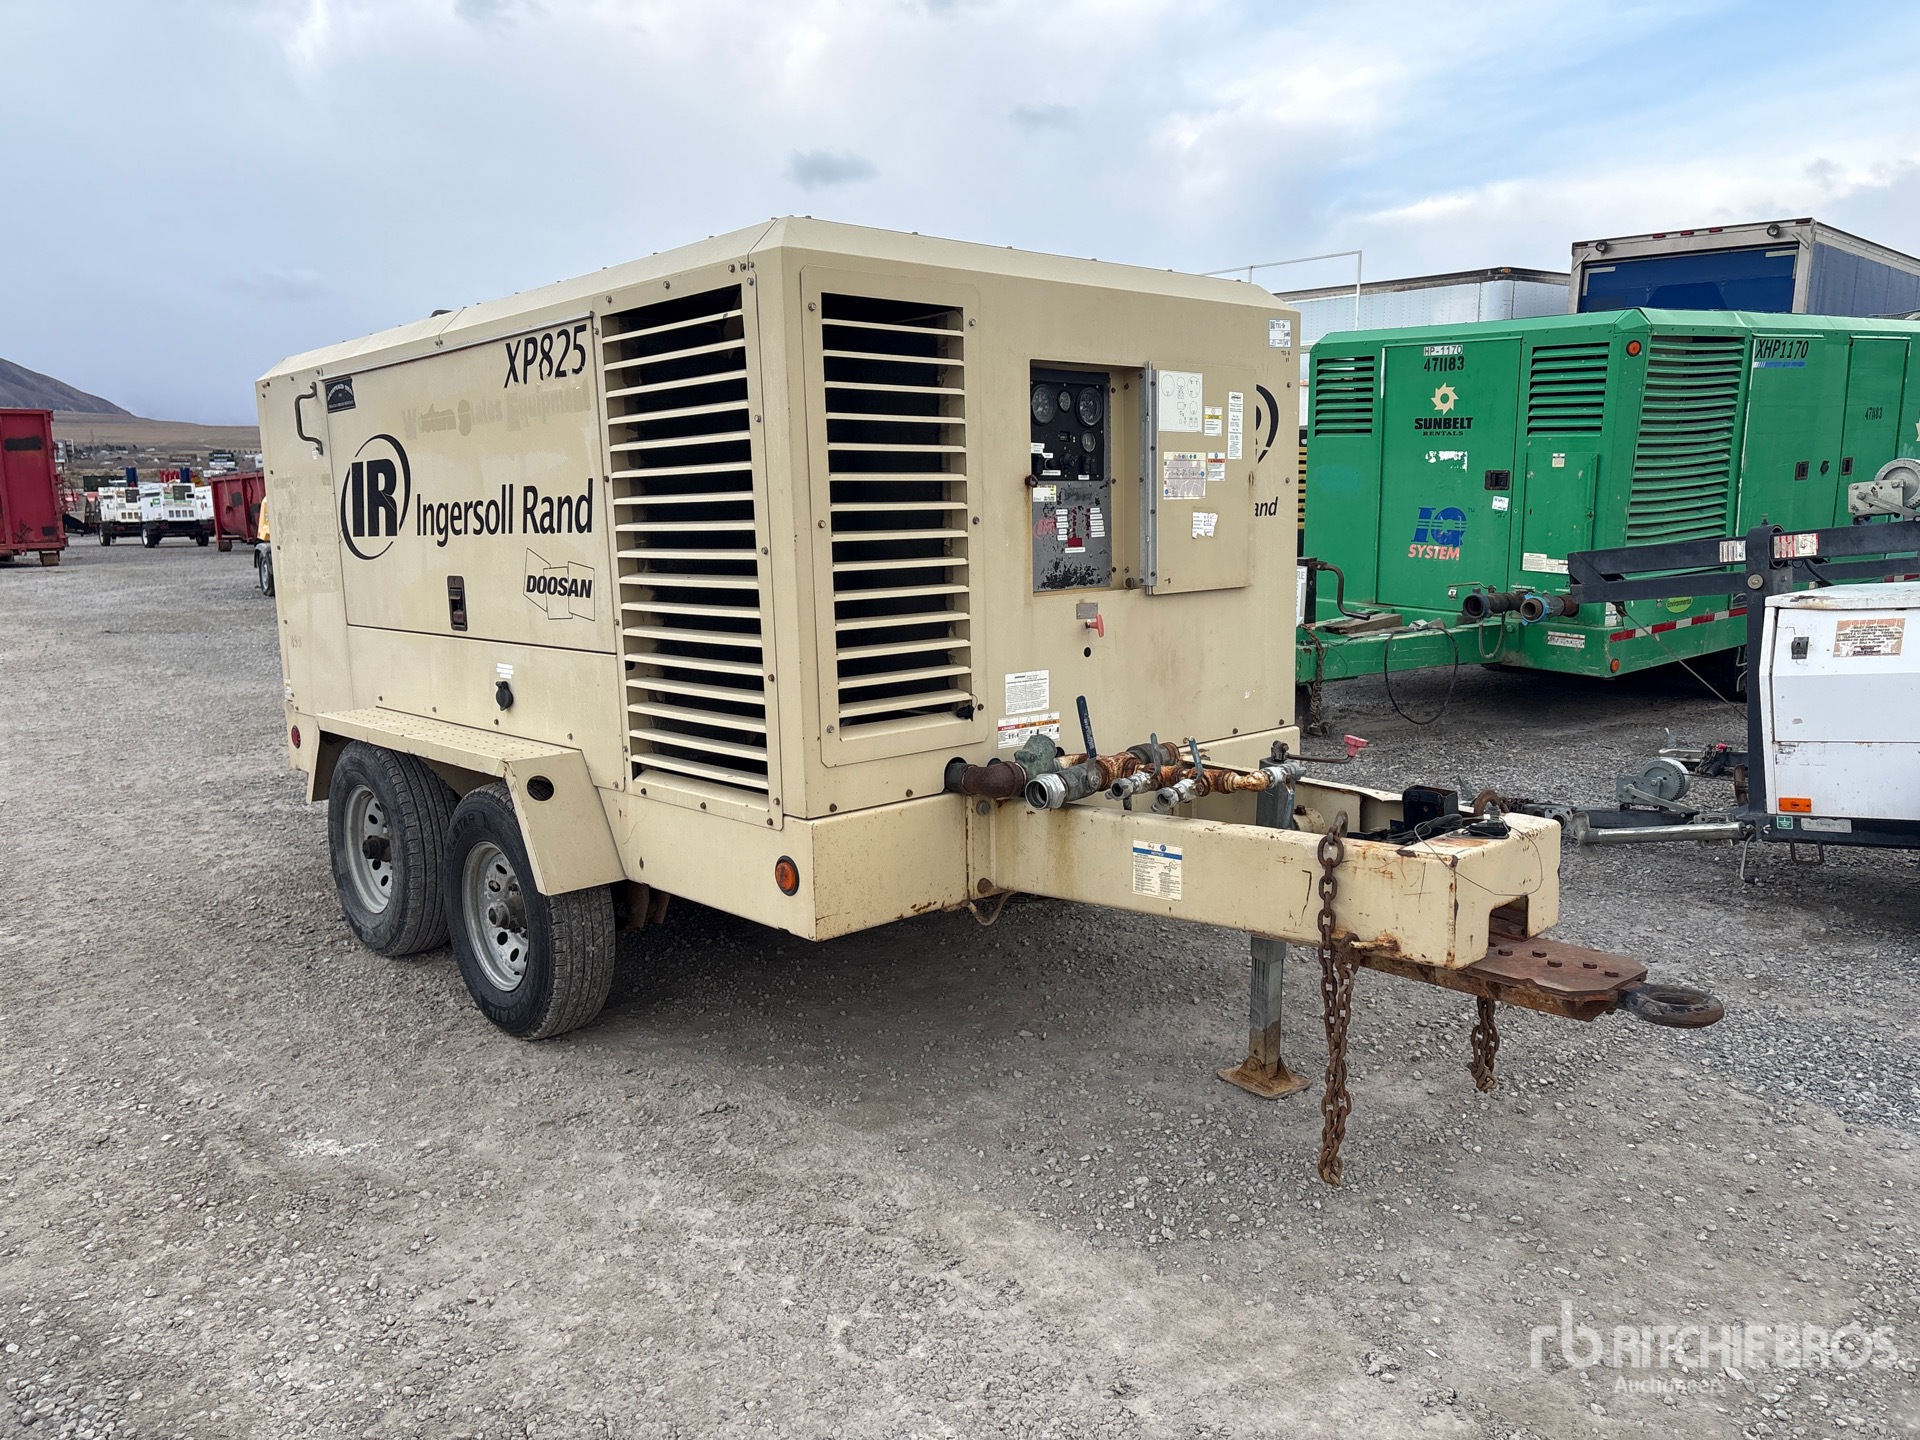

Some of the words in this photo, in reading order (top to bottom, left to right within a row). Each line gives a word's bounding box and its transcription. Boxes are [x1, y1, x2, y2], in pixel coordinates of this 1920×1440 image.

[504, 324, 587, 388] XP825
[1424, 346, 1463, 355] HP-1170
[1754, 339, 1809, 359] XHP1170
[1423, 356, 1465, 372] 471183
[1414, 417, 1474, 430] SUNBELT
[351, 458, 398, 538] IR
[416, 483, 514, 547] Ingersoll
[522, 477, 594, 535] Rand
[1408, 544, 1460, 560] SYSTEM
[526, 574, 592, 599] DOOSAN
